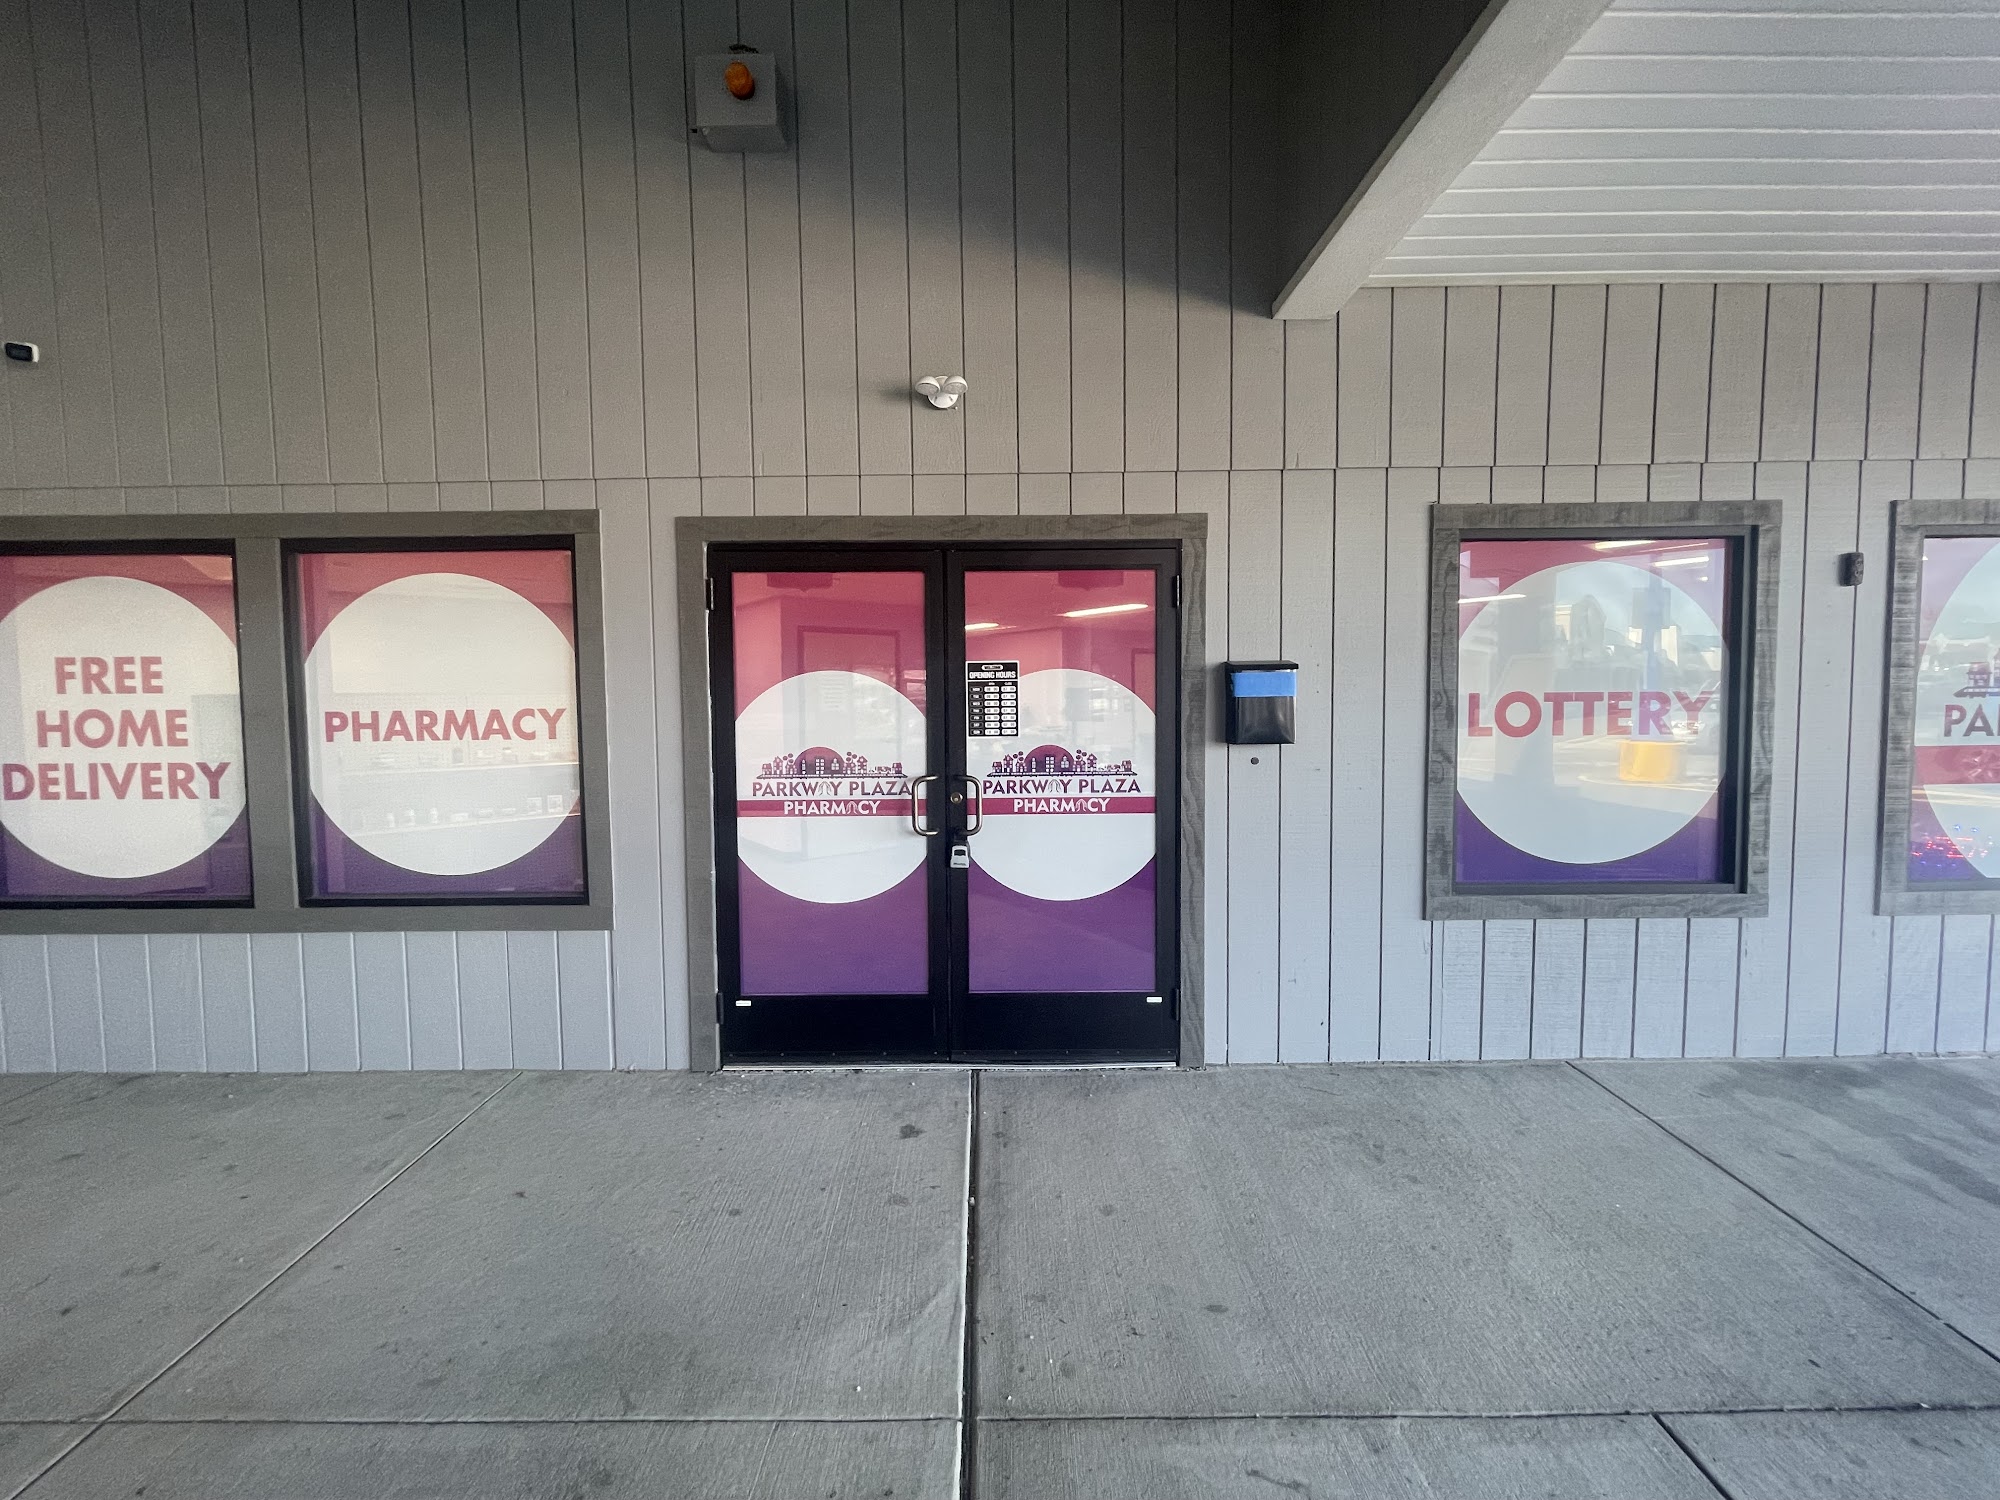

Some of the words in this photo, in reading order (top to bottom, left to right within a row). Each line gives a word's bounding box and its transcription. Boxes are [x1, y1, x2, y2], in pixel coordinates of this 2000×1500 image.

[55, 656, 163, 695] FREE
[969, 671, 995, 679] OPENING
[996, 670, 1016, 679] HOURS
[36, 709, 188, 748] HOME
[325, 708, 567, 743] PHARMACY
[1468, 690, 1714, 738] LOTTERY
[2, 762, 231, 801] DELIVERY
[850, 781, 912, 796] PLAZA
[1079, 779, 1141, 794] PLAZA
